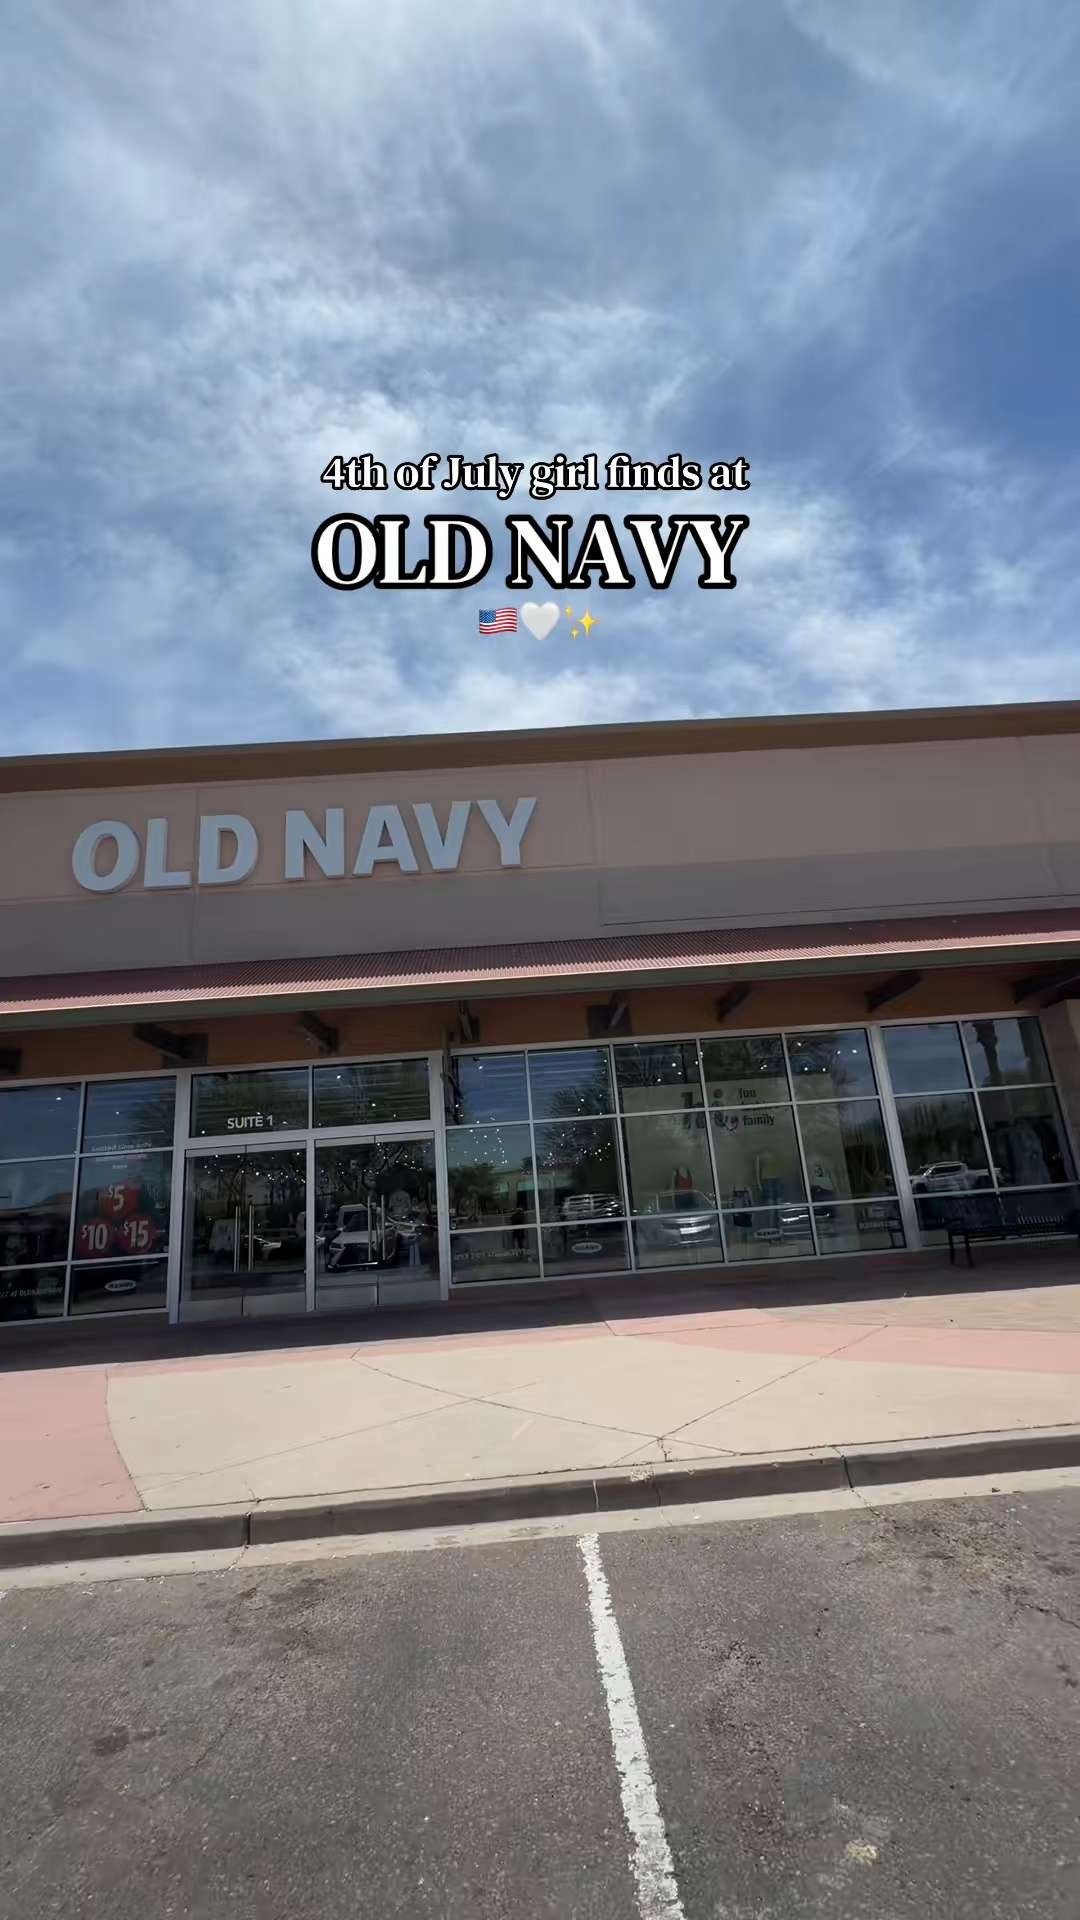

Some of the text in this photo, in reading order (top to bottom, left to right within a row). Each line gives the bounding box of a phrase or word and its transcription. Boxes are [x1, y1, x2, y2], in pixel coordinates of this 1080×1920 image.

[71, 797, 538, 894] OLD NAVY
[227, 1114, 273, 1129] SUITE 1
[743, 1112, 776, 1127] family
[108, 1184, 126, 1212] $5
[81, 1223, 109, 1251] $10
[123, 1220, 149, 1249] $15
